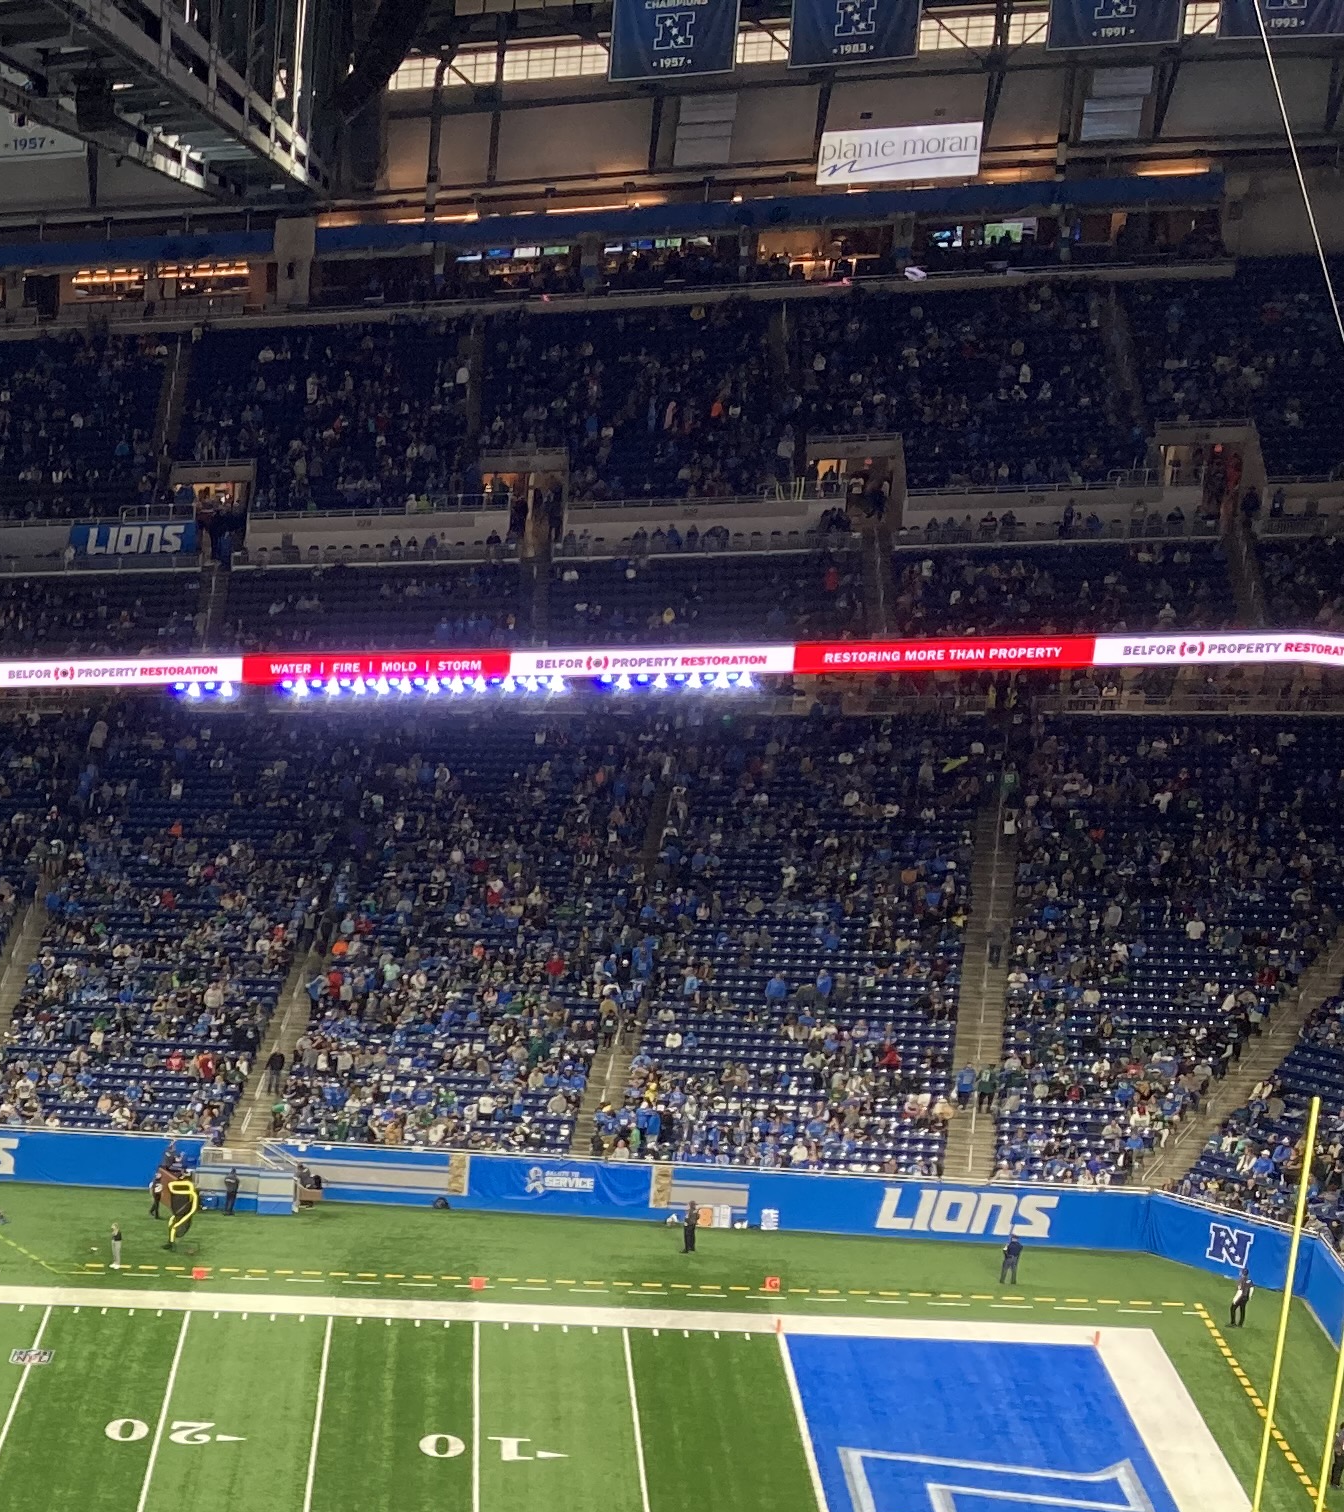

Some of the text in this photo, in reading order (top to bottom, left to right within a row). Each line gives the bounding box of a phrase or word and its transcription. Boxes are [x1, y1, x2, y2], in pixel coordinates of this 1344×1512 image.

[12, 137, 46, 150] 1957
[821, 132, 980, 166] plante moran
[86, 524, 186, 556] LIONS
[824, 644, 1062, 664] RESTORING MORE THAN PROPERTY
[1122, 641, 1282, 658] BELFOR PROPERTY
[269, 660, 482, 674] WATER FIRE MOLD STORM
[535, 654, 768, 670] BELFOR PROPERTY RESTORATION
[7, 664, 218, 680] BELFOR PROPERTY RESTORATION
[544, 1176, 595, 1190] SERVICE
[875, 1186, 1060, 1238] LIONS
[103, 1418, 216, 1445] 20
[418, 1434, 533, 1462] 10
